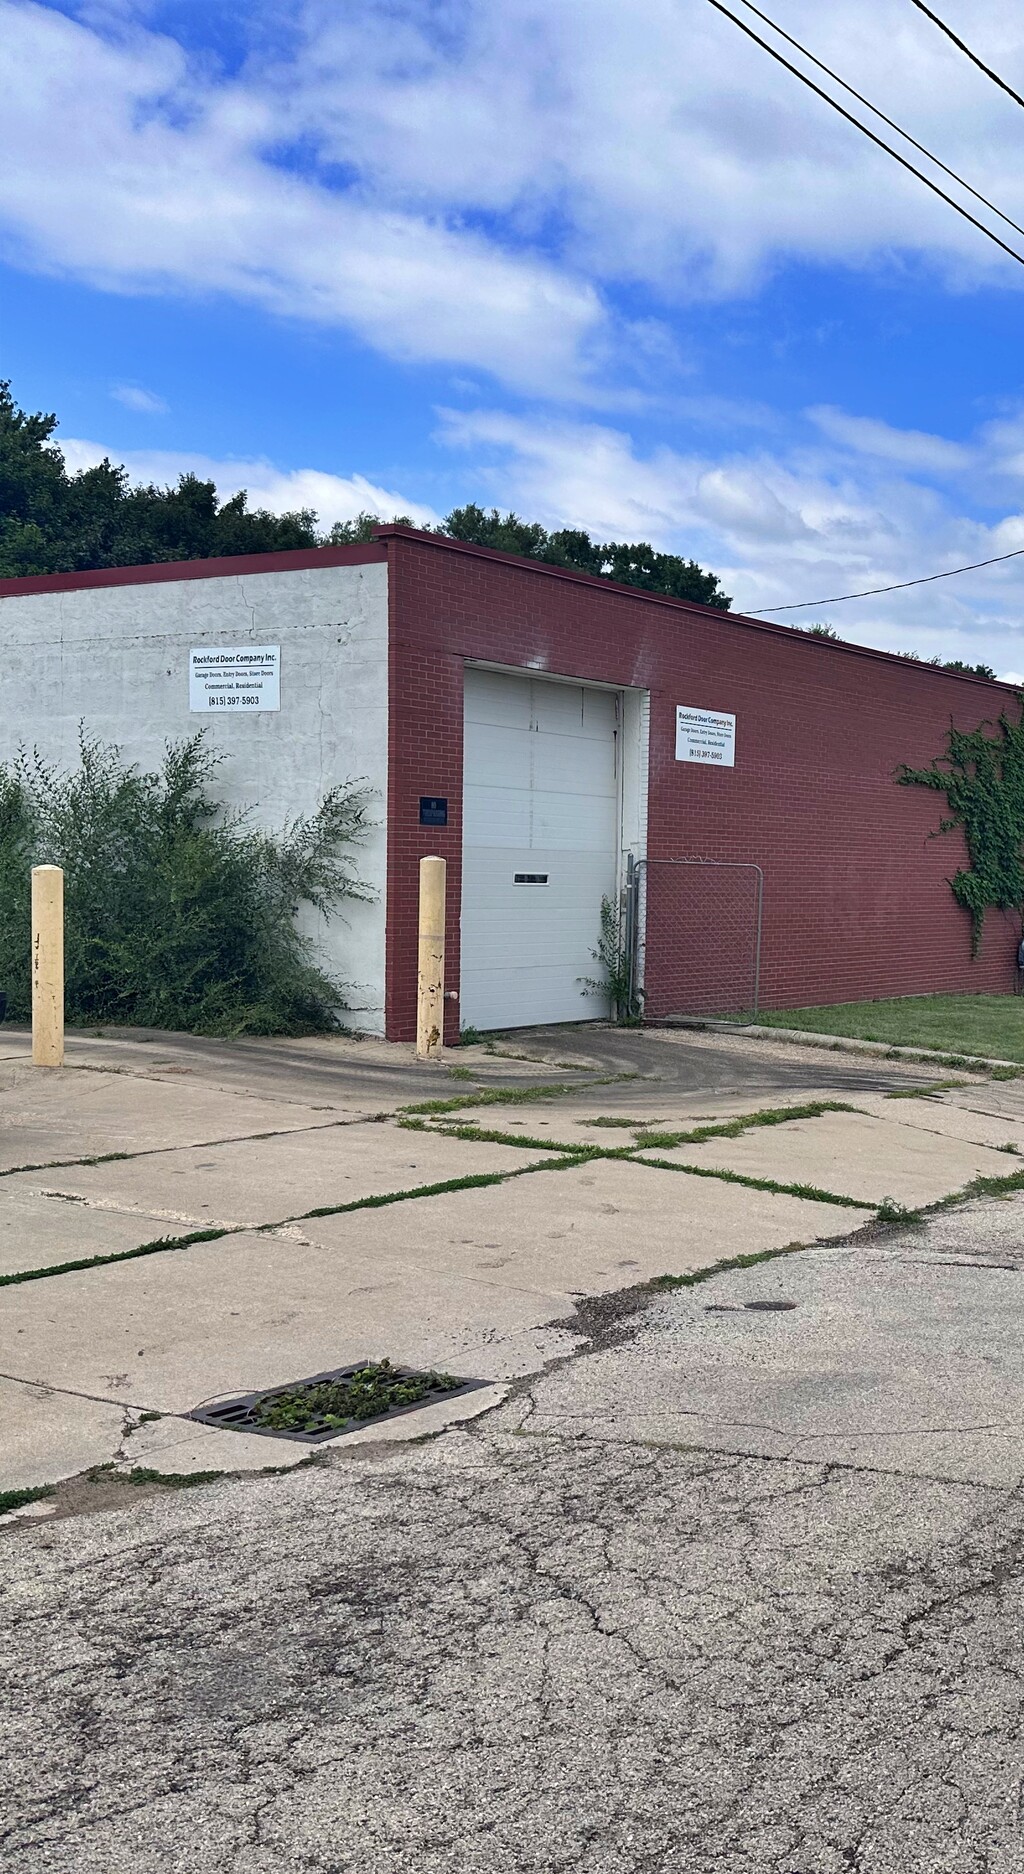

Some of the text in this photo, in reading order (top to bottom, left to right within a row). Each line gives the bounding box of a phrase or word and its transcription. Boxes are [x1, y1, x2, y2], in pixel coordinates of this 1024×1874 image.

[193, 655, 219, 663] Rockford
[220, 654, 235, 662] Door
[236, 654, 264, 664] Company
[209, 696, 259, 706] (815) 397-5903
[679, 712, 697, 722] Rockford
[708, 716, 726, 727] Company
[689, 748, 722, 760] (815) 397-5903
